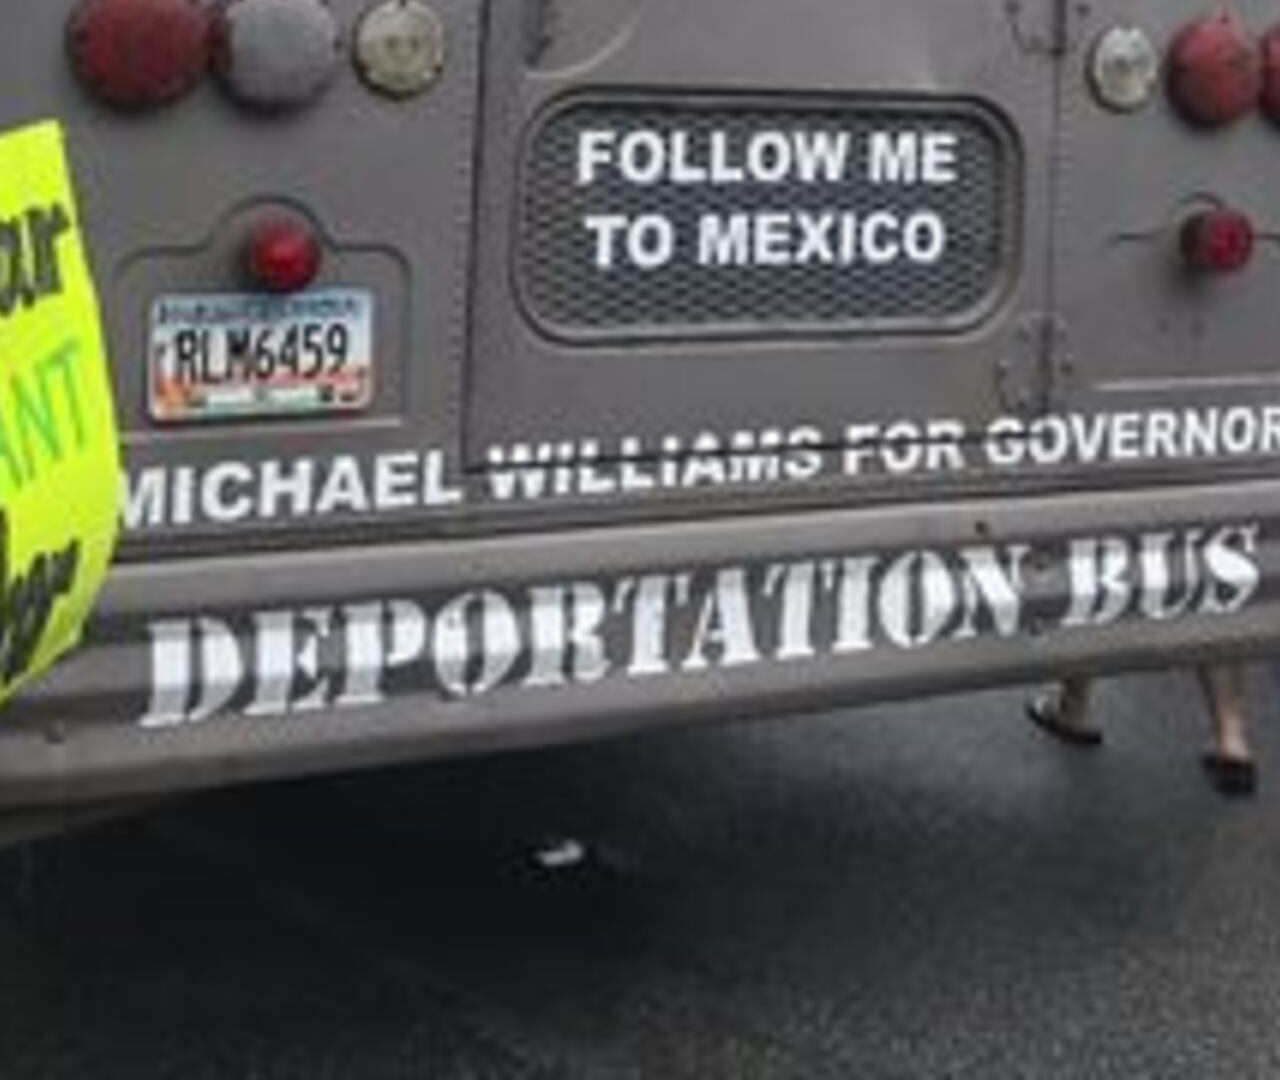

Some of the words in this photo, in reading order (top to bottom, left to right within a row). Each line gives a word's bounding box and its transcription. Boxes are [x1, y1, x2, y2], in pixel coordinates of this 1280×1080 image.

[575, 131, 850, 184] FOLLOW
[869, 131, 960, 183] ME
[584, 214, 675, 268] TO
[697, 212, 946, 266] MEXICO
[118, 451, 462, 529] MICHAEL
[487, 426, 823, 500] WILLIAMS
[843, 420, 965, 475] FOR
[140, 544, 1030, 727] DEPORTATION
[1060, 524, 1260, 628] BUS
